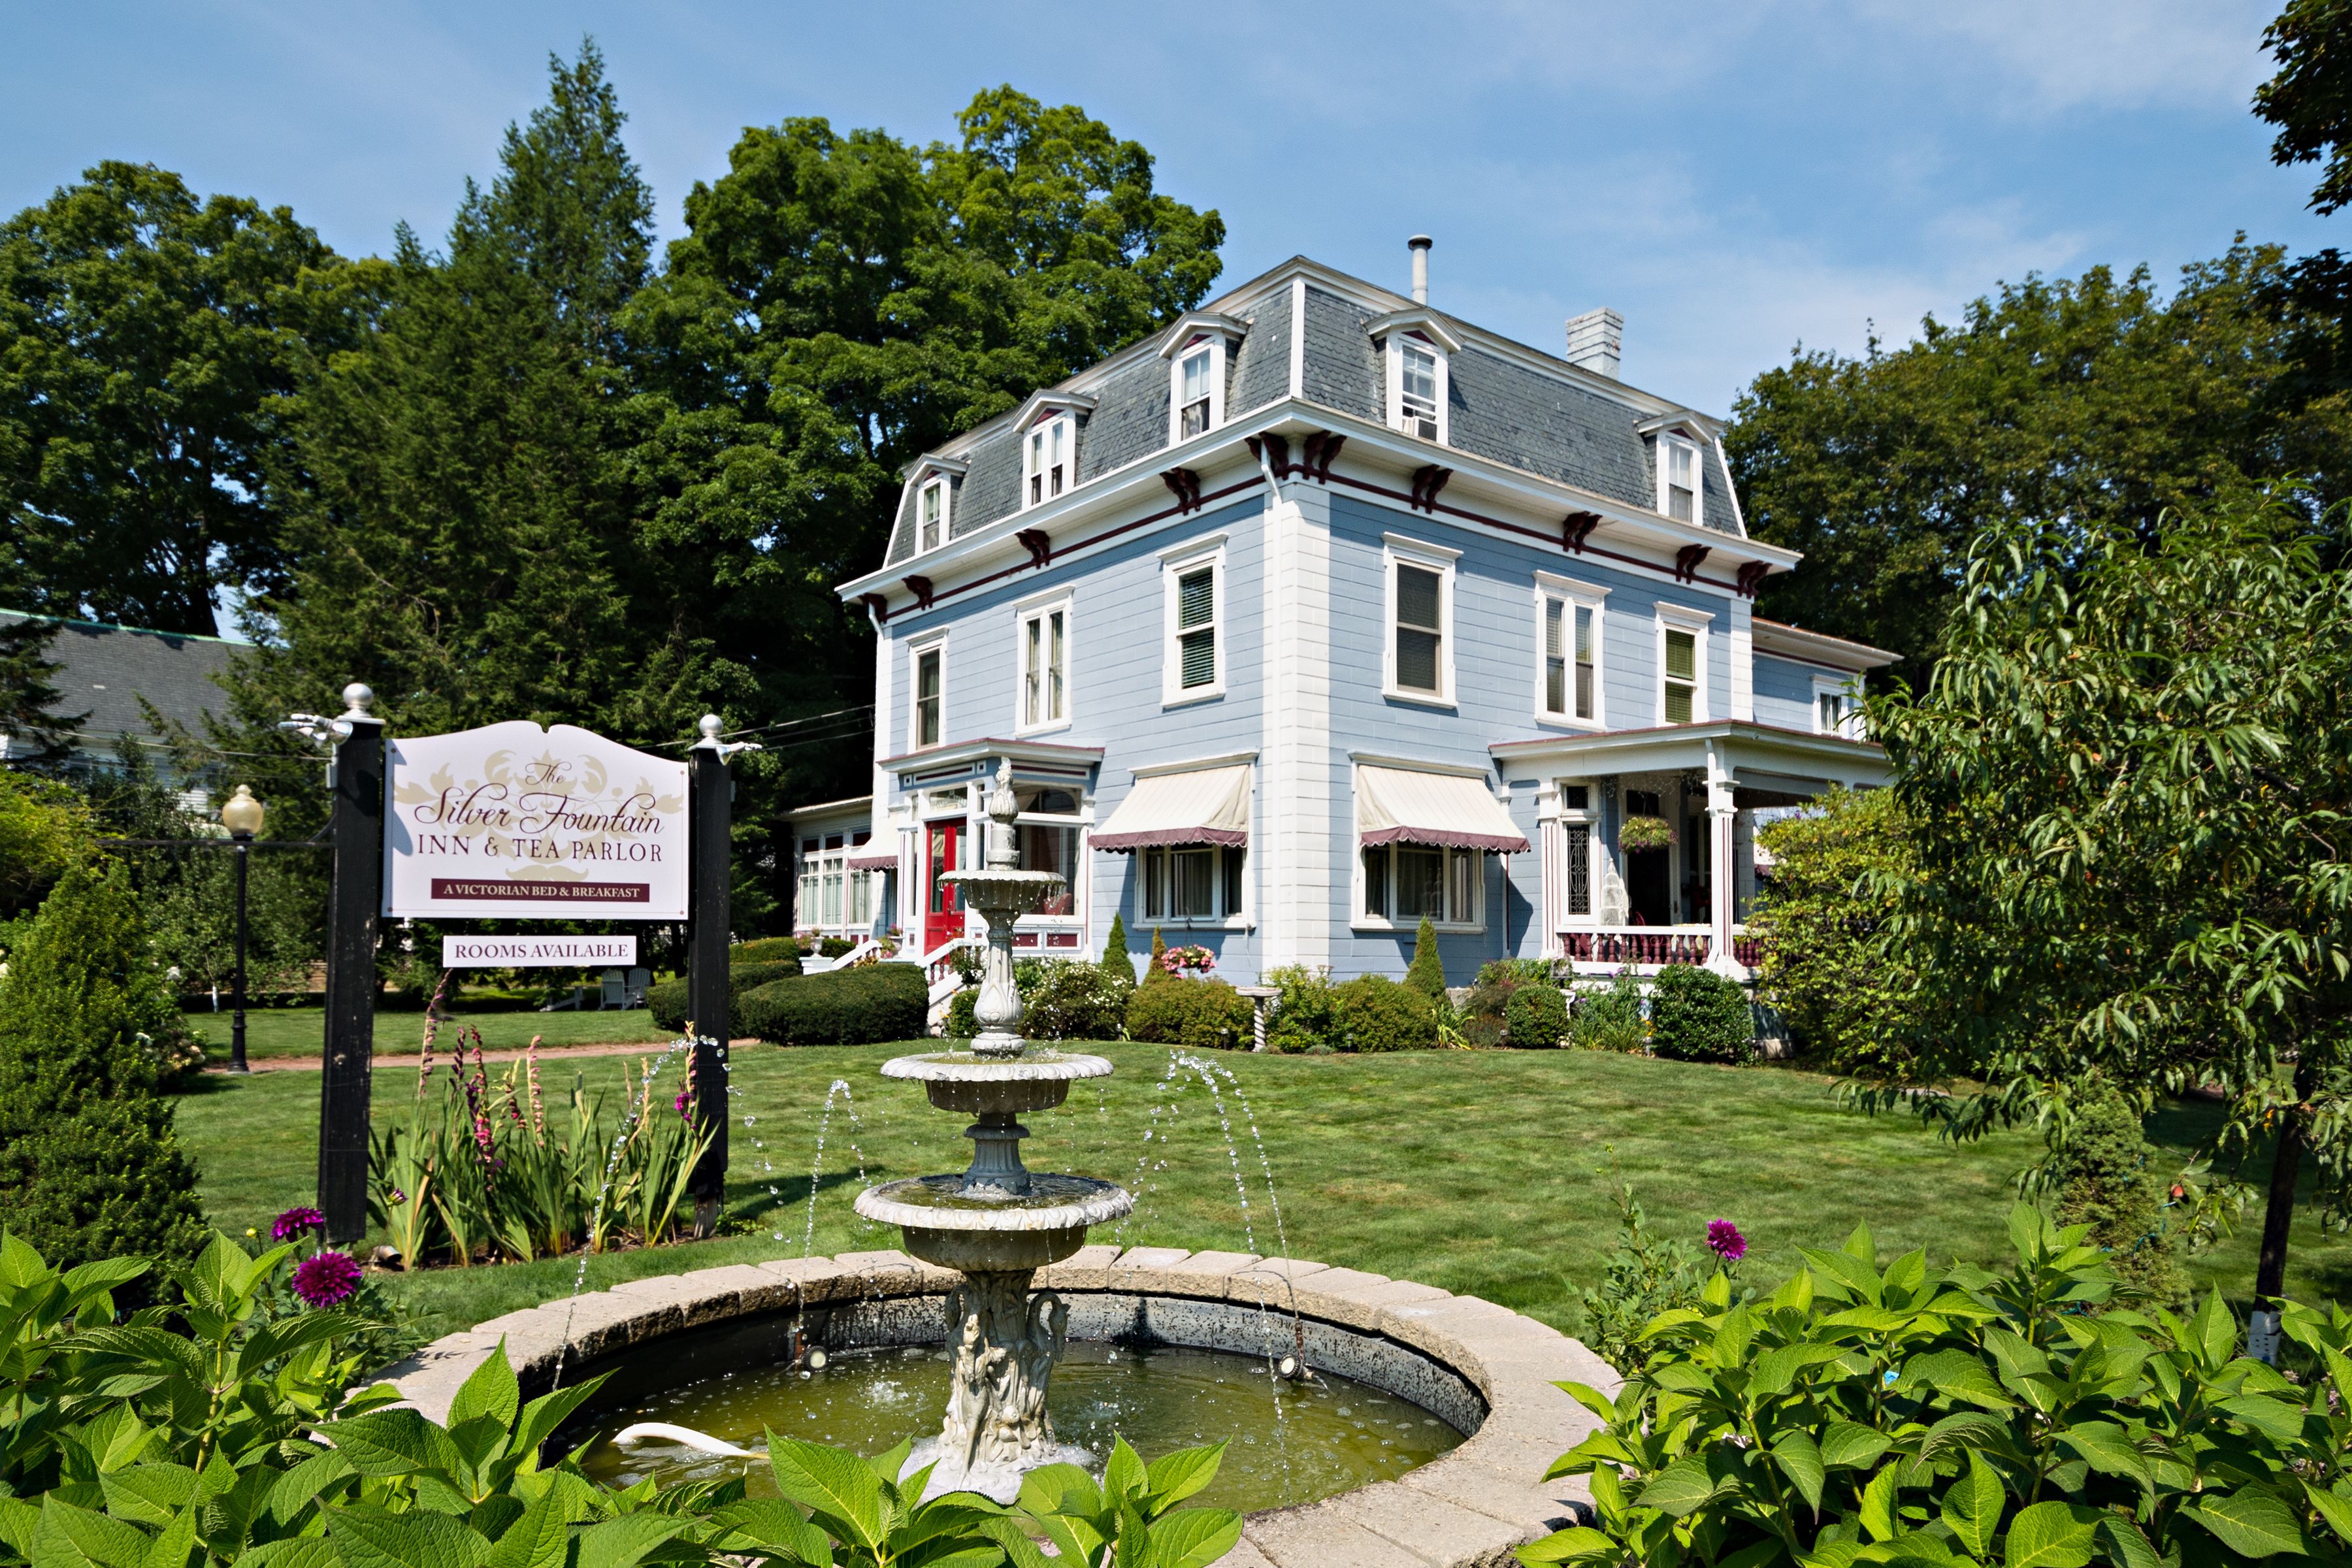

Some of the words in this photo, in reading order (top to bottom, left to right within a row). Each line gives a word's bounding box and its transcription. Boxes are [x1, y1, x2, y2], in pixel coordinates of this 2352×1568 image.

[525, 761, 572, 785] The
[414, 783, 511, 826] Silver
[519, 792, 664, 835] Fountain
[418, 834, 470, 855] INN
[484, 836, 499, 857] &
[512, 838, 560, 858] TEA
[572, 841, 662, 862] PARLOR
[444, 884, 453, 894] A
[455, 885, 530, 896] VICTORIAN
[532, 886, 557, 896] BED
[559, 887, 570, 896] &
[572, 887, 640, 898] BREAKFAST
[455, 944, 527, 958] ROOMS
[530, 944, 628, 958] AVAILABLE
